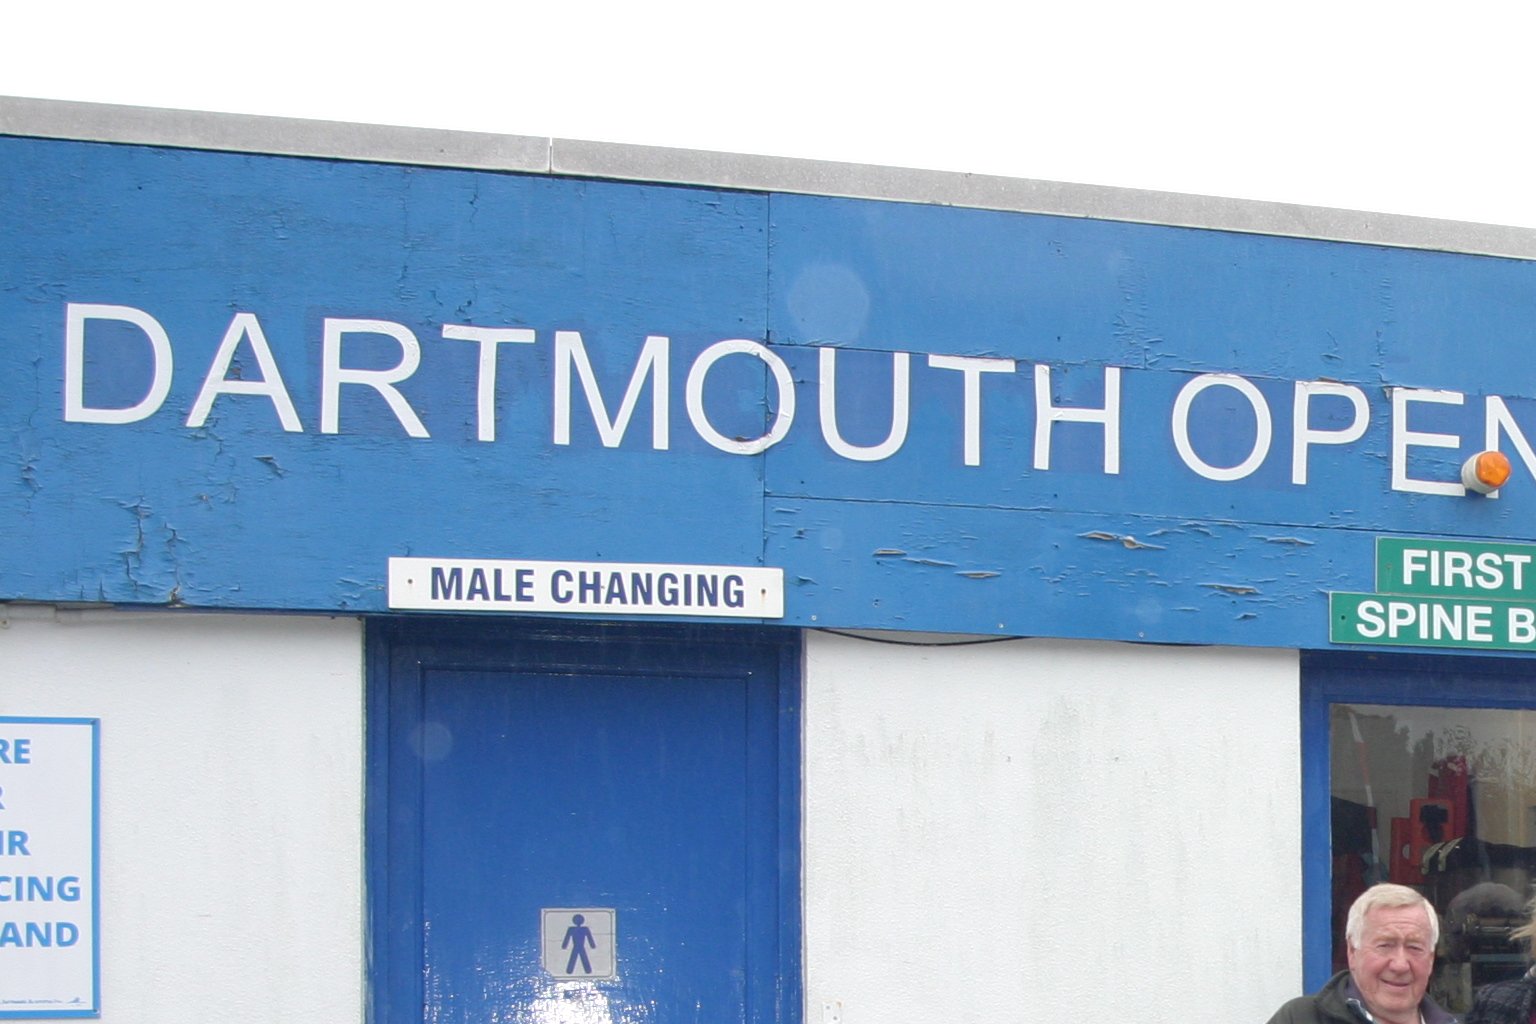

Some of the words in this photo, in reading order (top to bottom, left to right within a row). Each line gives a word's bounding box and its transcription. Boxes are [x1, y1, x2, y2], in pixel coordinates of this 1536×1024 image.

[64, 302, 1122, 475] DARTMOUTH
[430, 567, 536, 603] MALE
[550, 570, 746, 609] CHANGING
[1402, 548, 1532, 591] FIRST
[1355, 599, 1493, 642] SPINE
